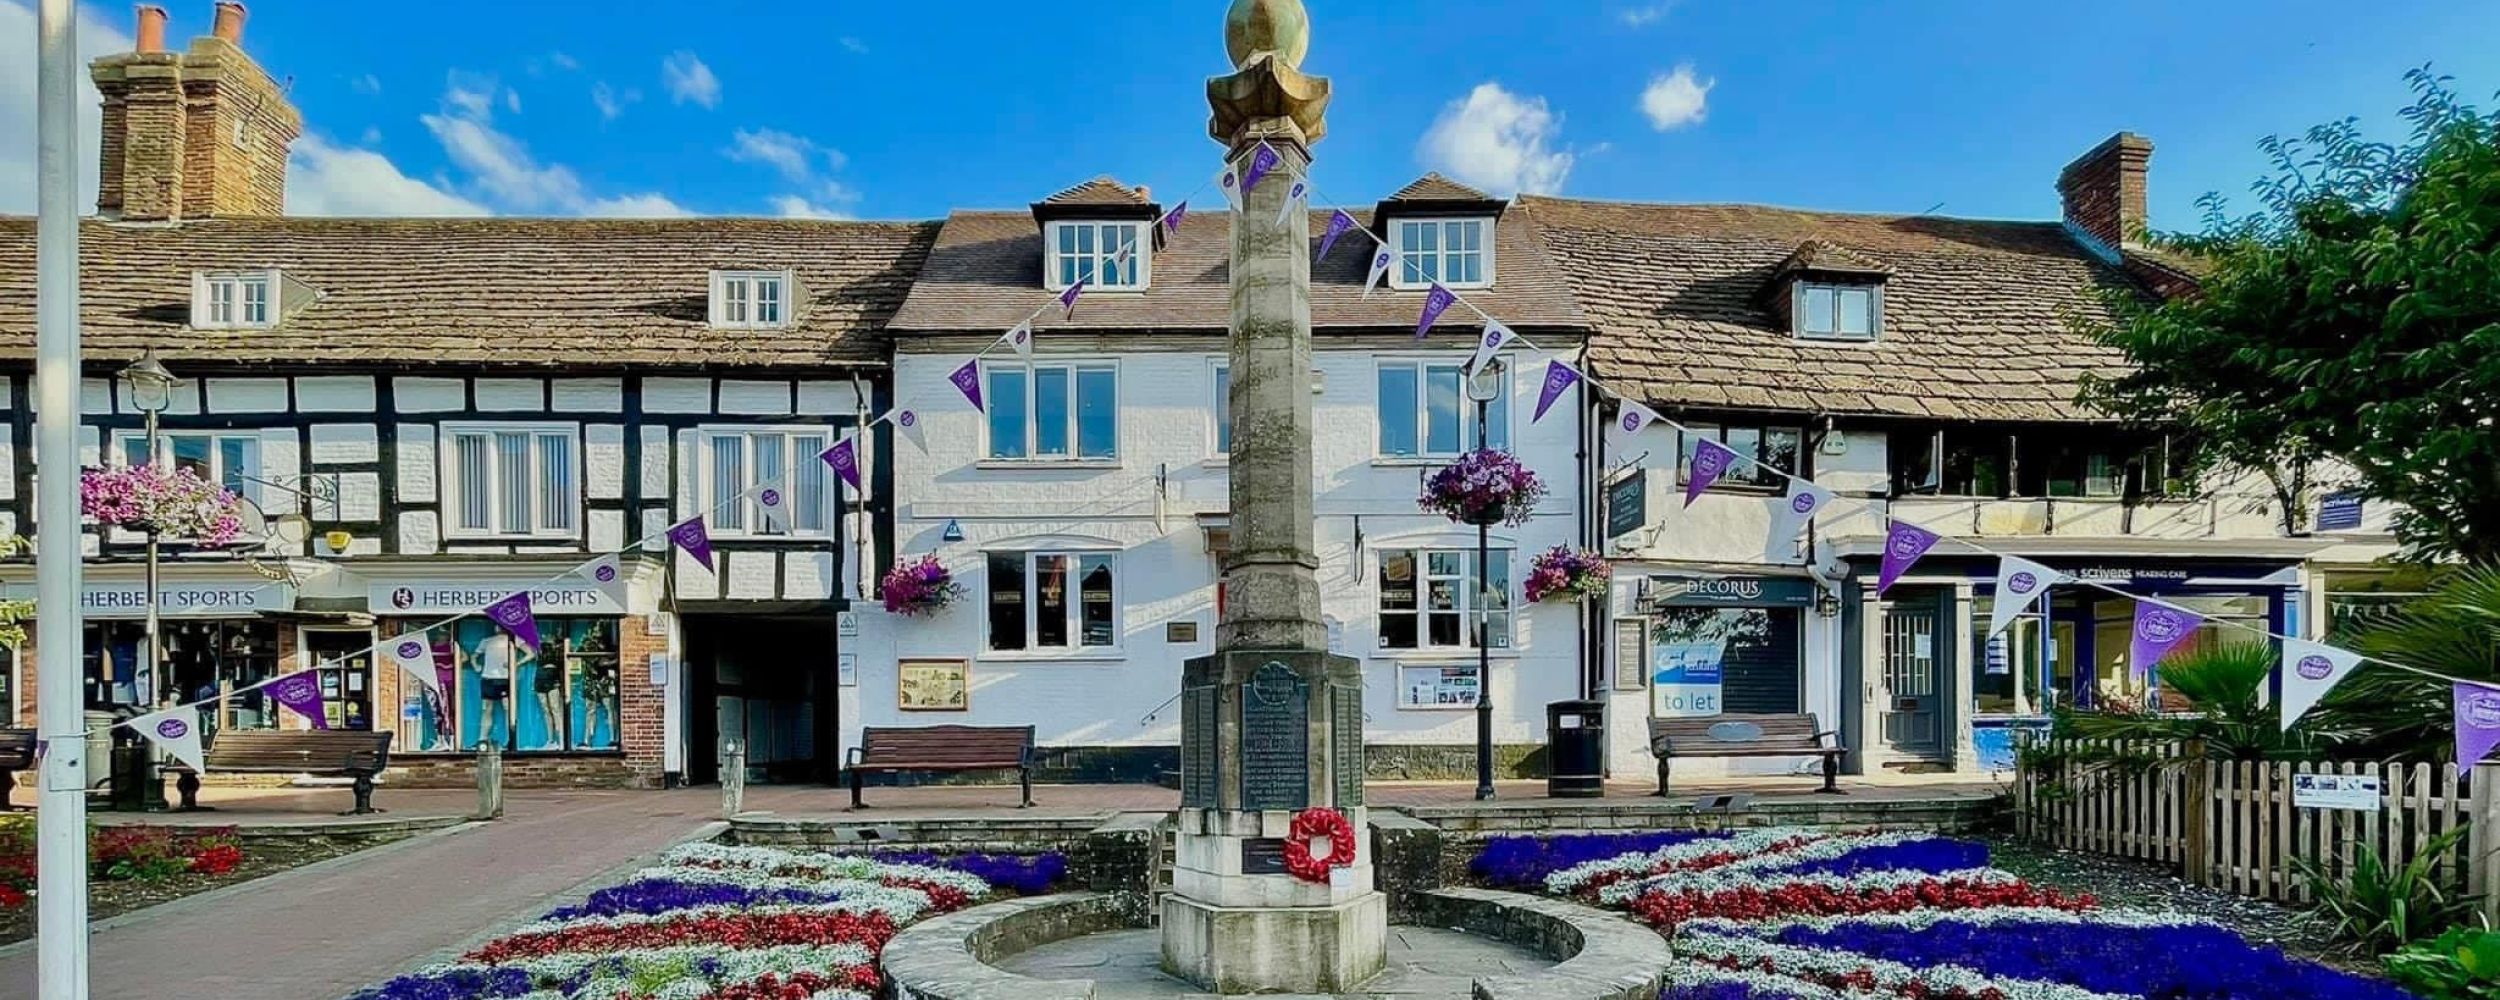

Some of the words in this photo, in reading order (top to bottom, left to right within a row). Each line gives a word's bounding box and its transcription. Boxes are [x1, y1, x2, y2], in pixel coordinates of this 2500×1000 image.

[2080, 564, 2133, 580] scrivens
[532, 590, 598, 605] PORTS
[1687, 581, 1763, 599] DECORUS
[81, 591, 172, 608] HERBET
[177, 591, 255, 607] SPORTS
[1665, 693, 1683, 710] to
[1690, 691, 1715, 710] let
